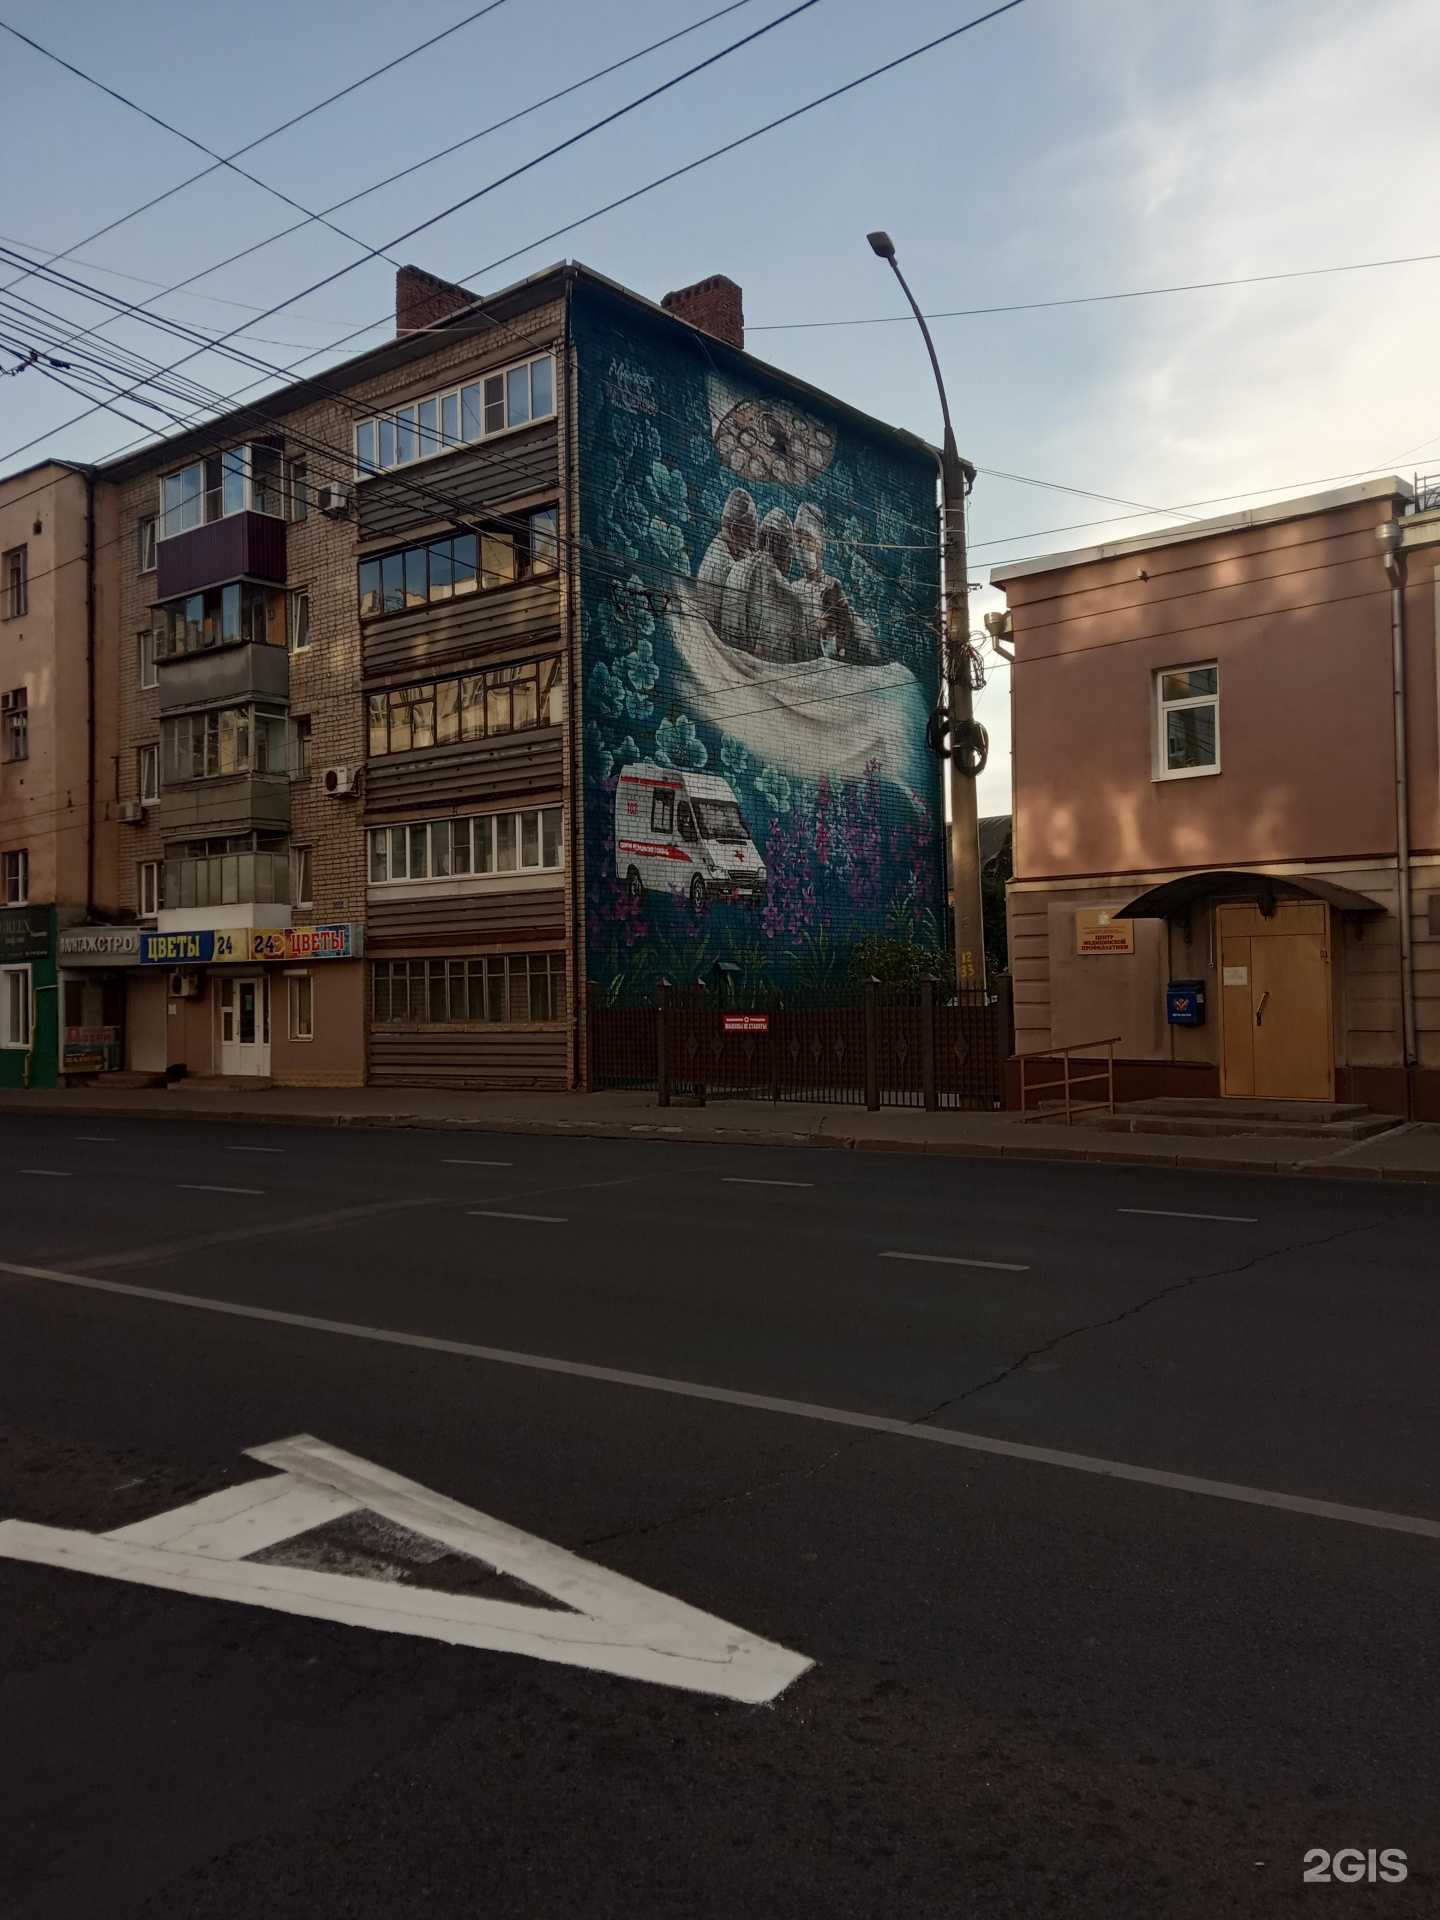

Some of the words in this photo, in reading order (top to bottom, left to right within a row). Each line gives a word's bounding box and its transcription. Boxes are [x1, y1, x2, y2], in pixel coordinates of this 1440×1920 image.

[148, 936, 200, 961] ЦВЕТЫ
[217, 936, 233, 955] 24
[254, 935, 275, 954] 24
[291, 930, 344, 955] ЦВЕТЫ
